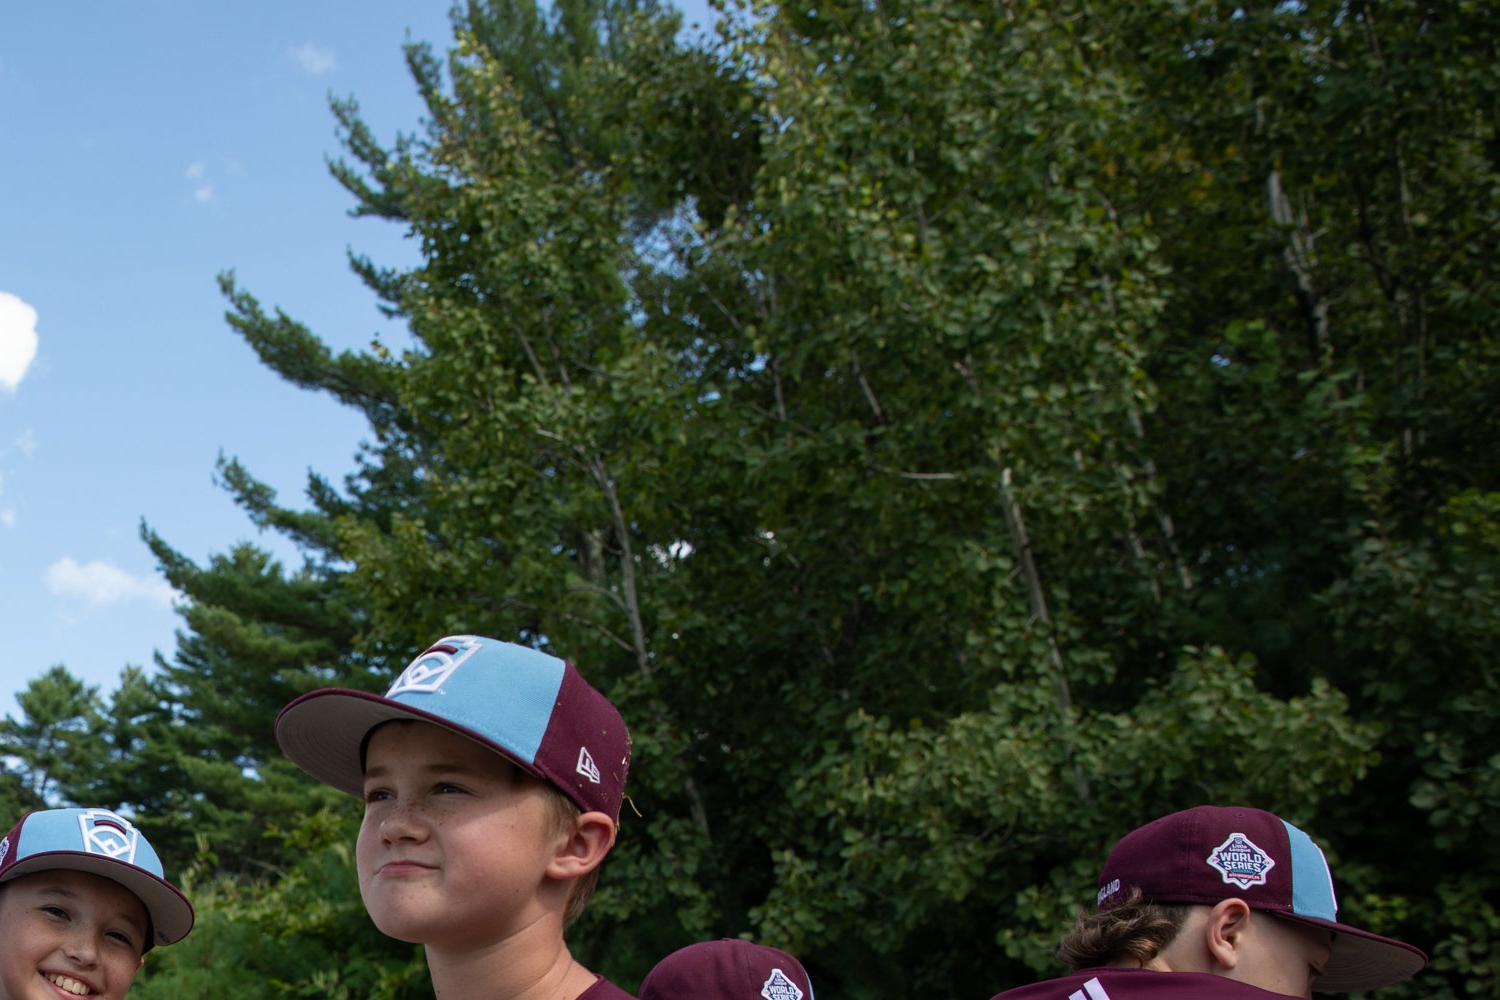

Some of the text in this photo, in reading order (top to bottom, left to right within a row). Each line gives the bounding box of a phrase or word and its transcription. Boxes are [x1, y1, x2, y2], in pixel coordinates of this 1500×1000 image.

[1220, 852, 1262, 864] WORLD
[1223, 861, 1261, 873] SERIES
[769, 986, 795, 995] WORLD
